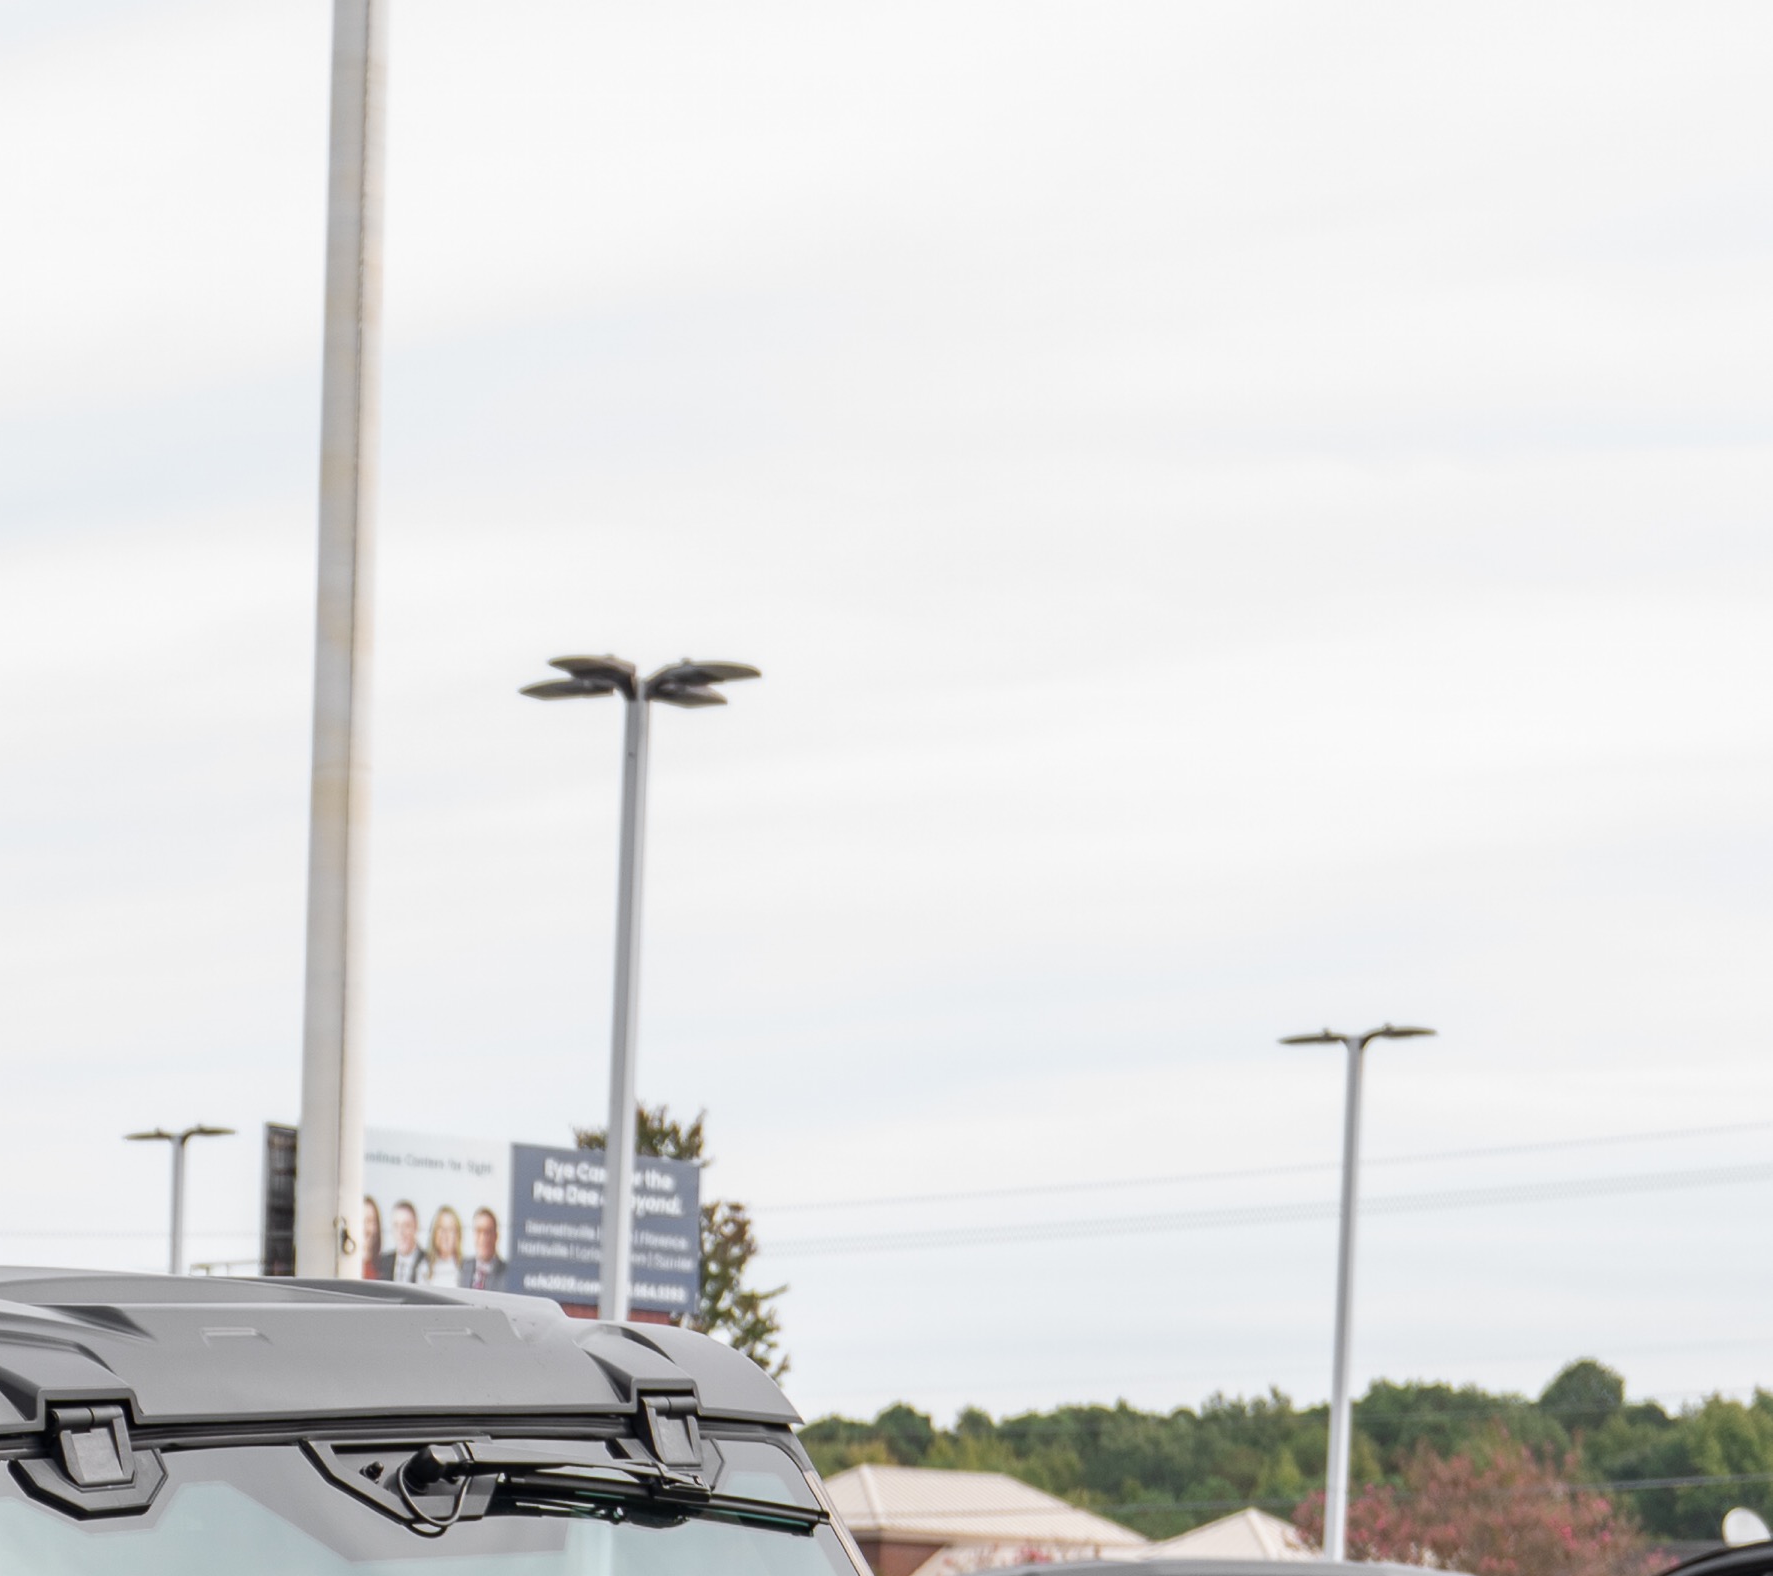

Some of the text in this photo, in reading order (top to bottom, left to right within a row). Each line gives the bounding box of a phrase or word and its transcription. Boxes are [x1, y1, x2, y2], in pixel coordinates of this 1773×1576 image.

[544, 1157, 575, 1184] Eye
[577, 1161, 607, 1183] Car
[645, 1169, 674, 1192] the
[533, 1180, 564, 1202] Pee
[566, 1184, 599, 1207] Dee
